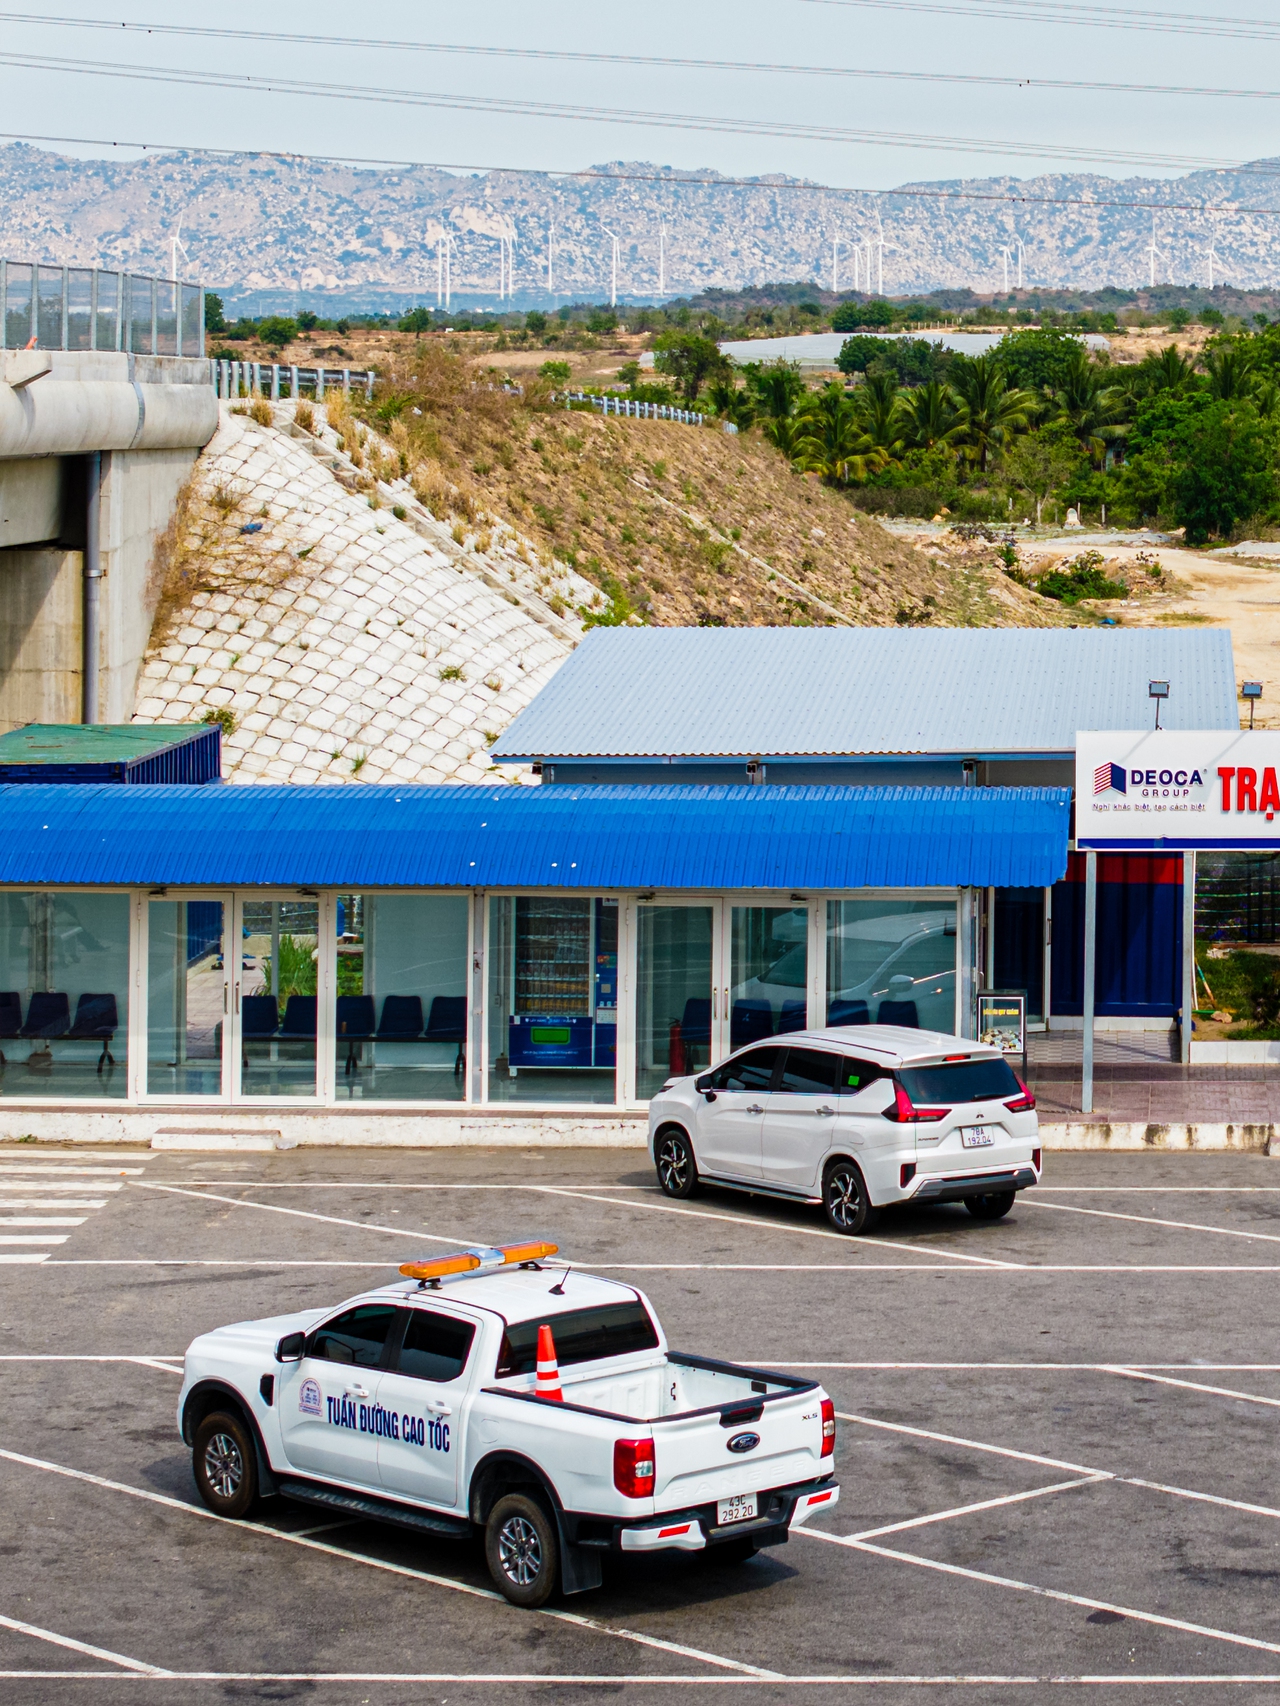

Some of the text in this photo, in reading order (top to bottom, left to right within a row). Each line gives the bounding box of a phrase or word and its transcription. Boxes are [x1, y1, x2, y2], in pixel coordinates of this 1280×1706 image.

[1131, 769, 1203, 786] DEOCA
[1142, 789, 1190, 797] GROUP
[1113, 803, 1131, 811] khác
[1154, 803, 1167, 813] tạo
[1170, 803, 1188, 811] cách
[1190, 803, 1206, 812] biệt
[971, 1127, 984, 1136] 78A
[968, 1136, 991, 1145] 192.04
[801, 1412, 818, 1421] XLS
[360, 1402, 400, 1440] ĐƯỜNG
[402, 1414, 425, 1447] CAO
[428, 1415, 450, 1453] TỐC
[729, 1494, 746, 1507] 43C
[722, 1505, 753, 1522] 292.20
